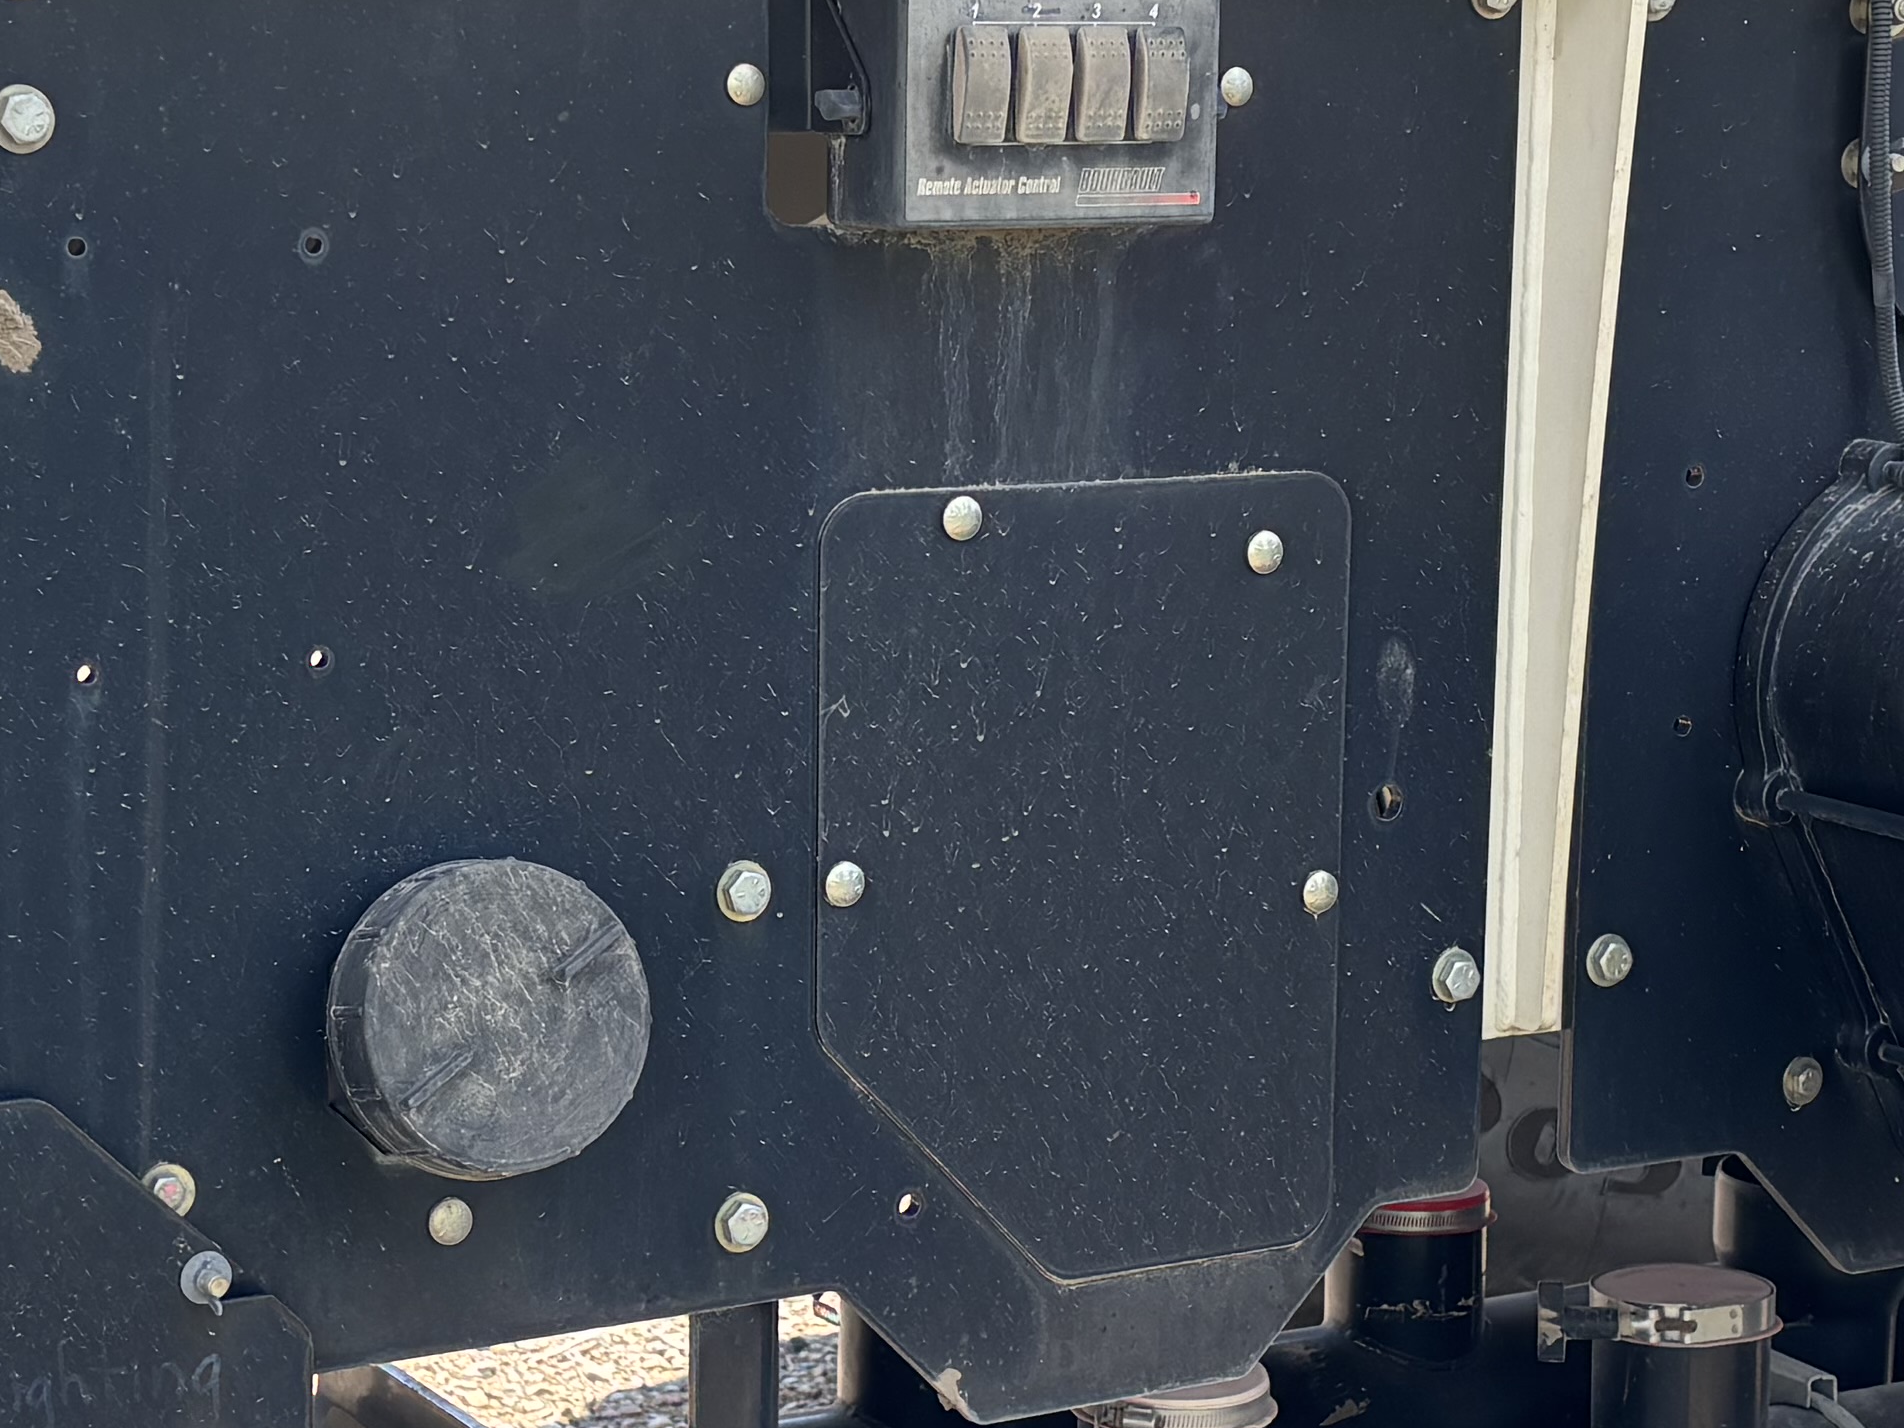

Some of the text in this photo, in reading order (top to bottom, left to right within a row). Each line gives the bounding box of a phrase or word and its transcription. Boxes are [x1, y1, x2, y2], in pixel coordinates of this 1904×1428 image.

[970, 3, 1159, 18] 1 2 3 4
[917, 176, 1061, 196] Remote Actuator Control
